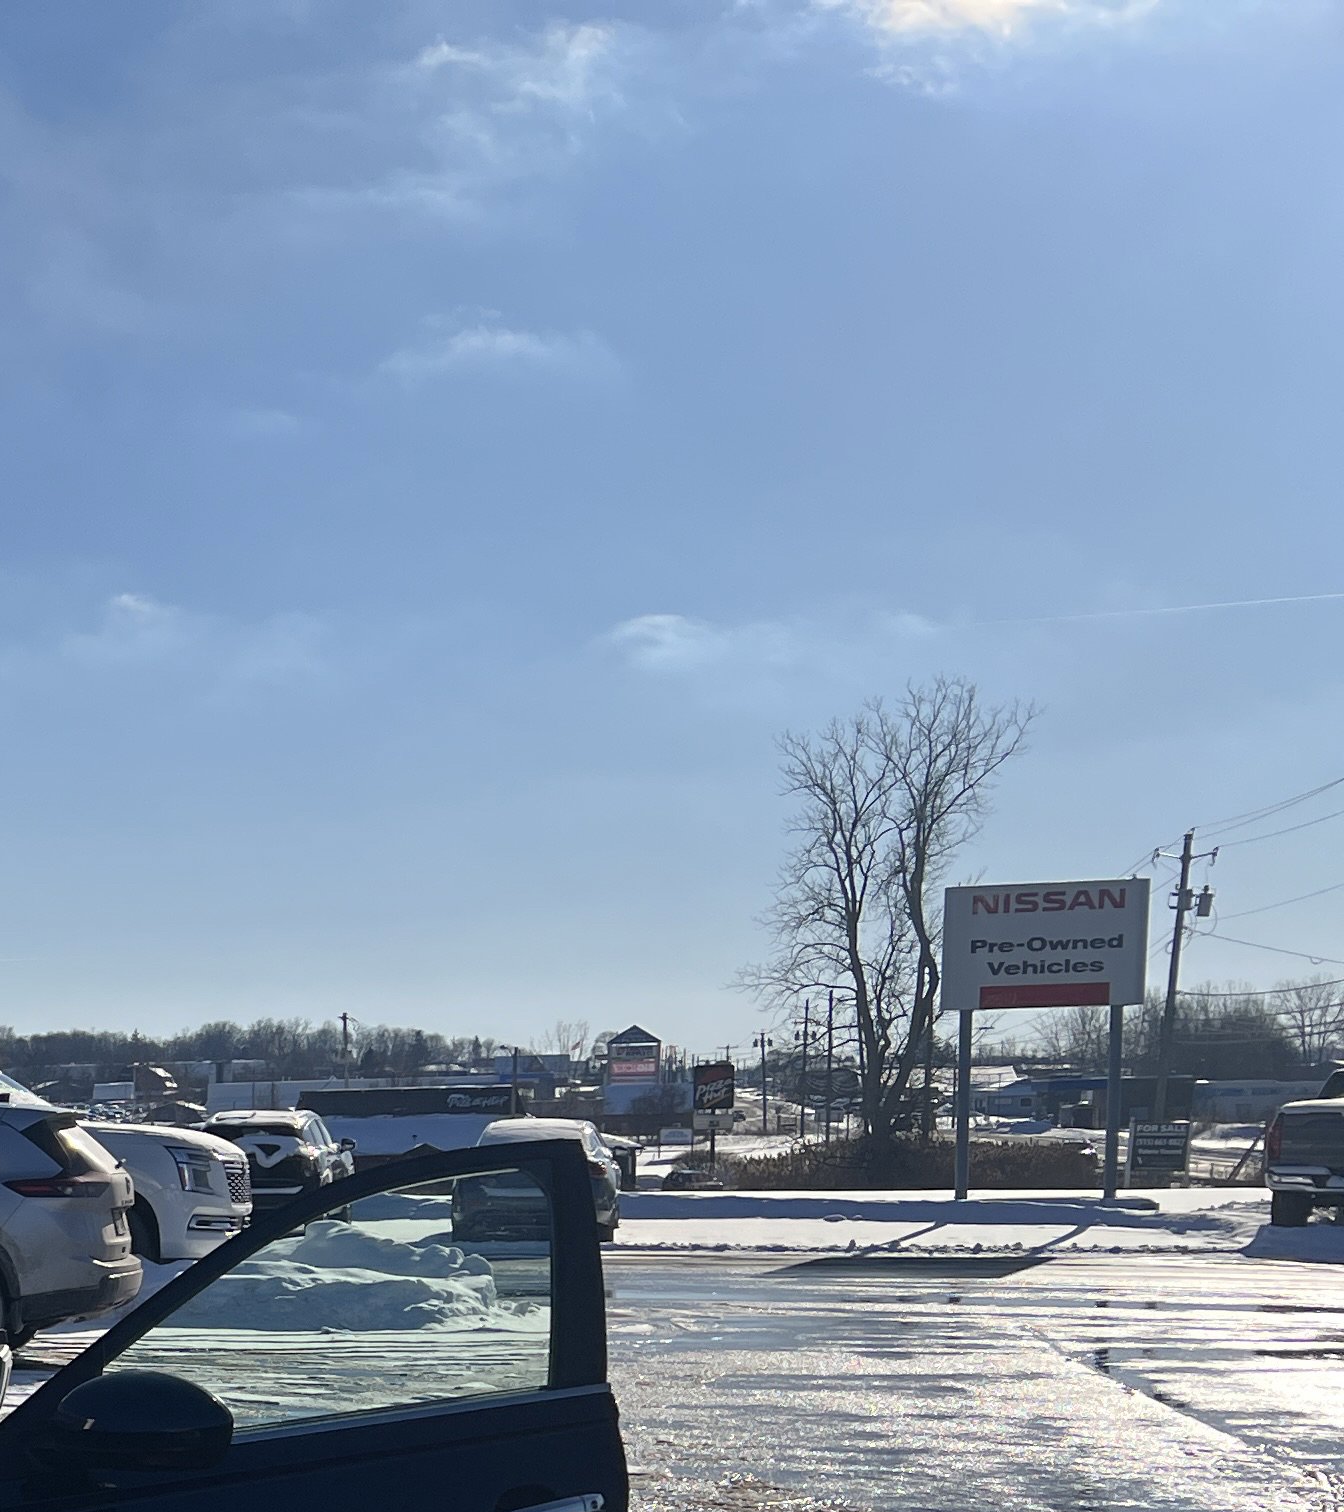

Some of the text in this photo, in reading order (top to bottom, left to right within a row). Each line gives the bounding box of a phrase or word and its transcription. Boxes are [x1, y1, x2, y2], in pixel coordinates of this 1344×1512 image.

[972, 888, 1127, 915] NISSAN
[970, 933, 1124, 954] Pre-Owned
[986, 959, 1105, 976] Vehicles
[1136, 1124, 1187, 1132] FOR SALE
